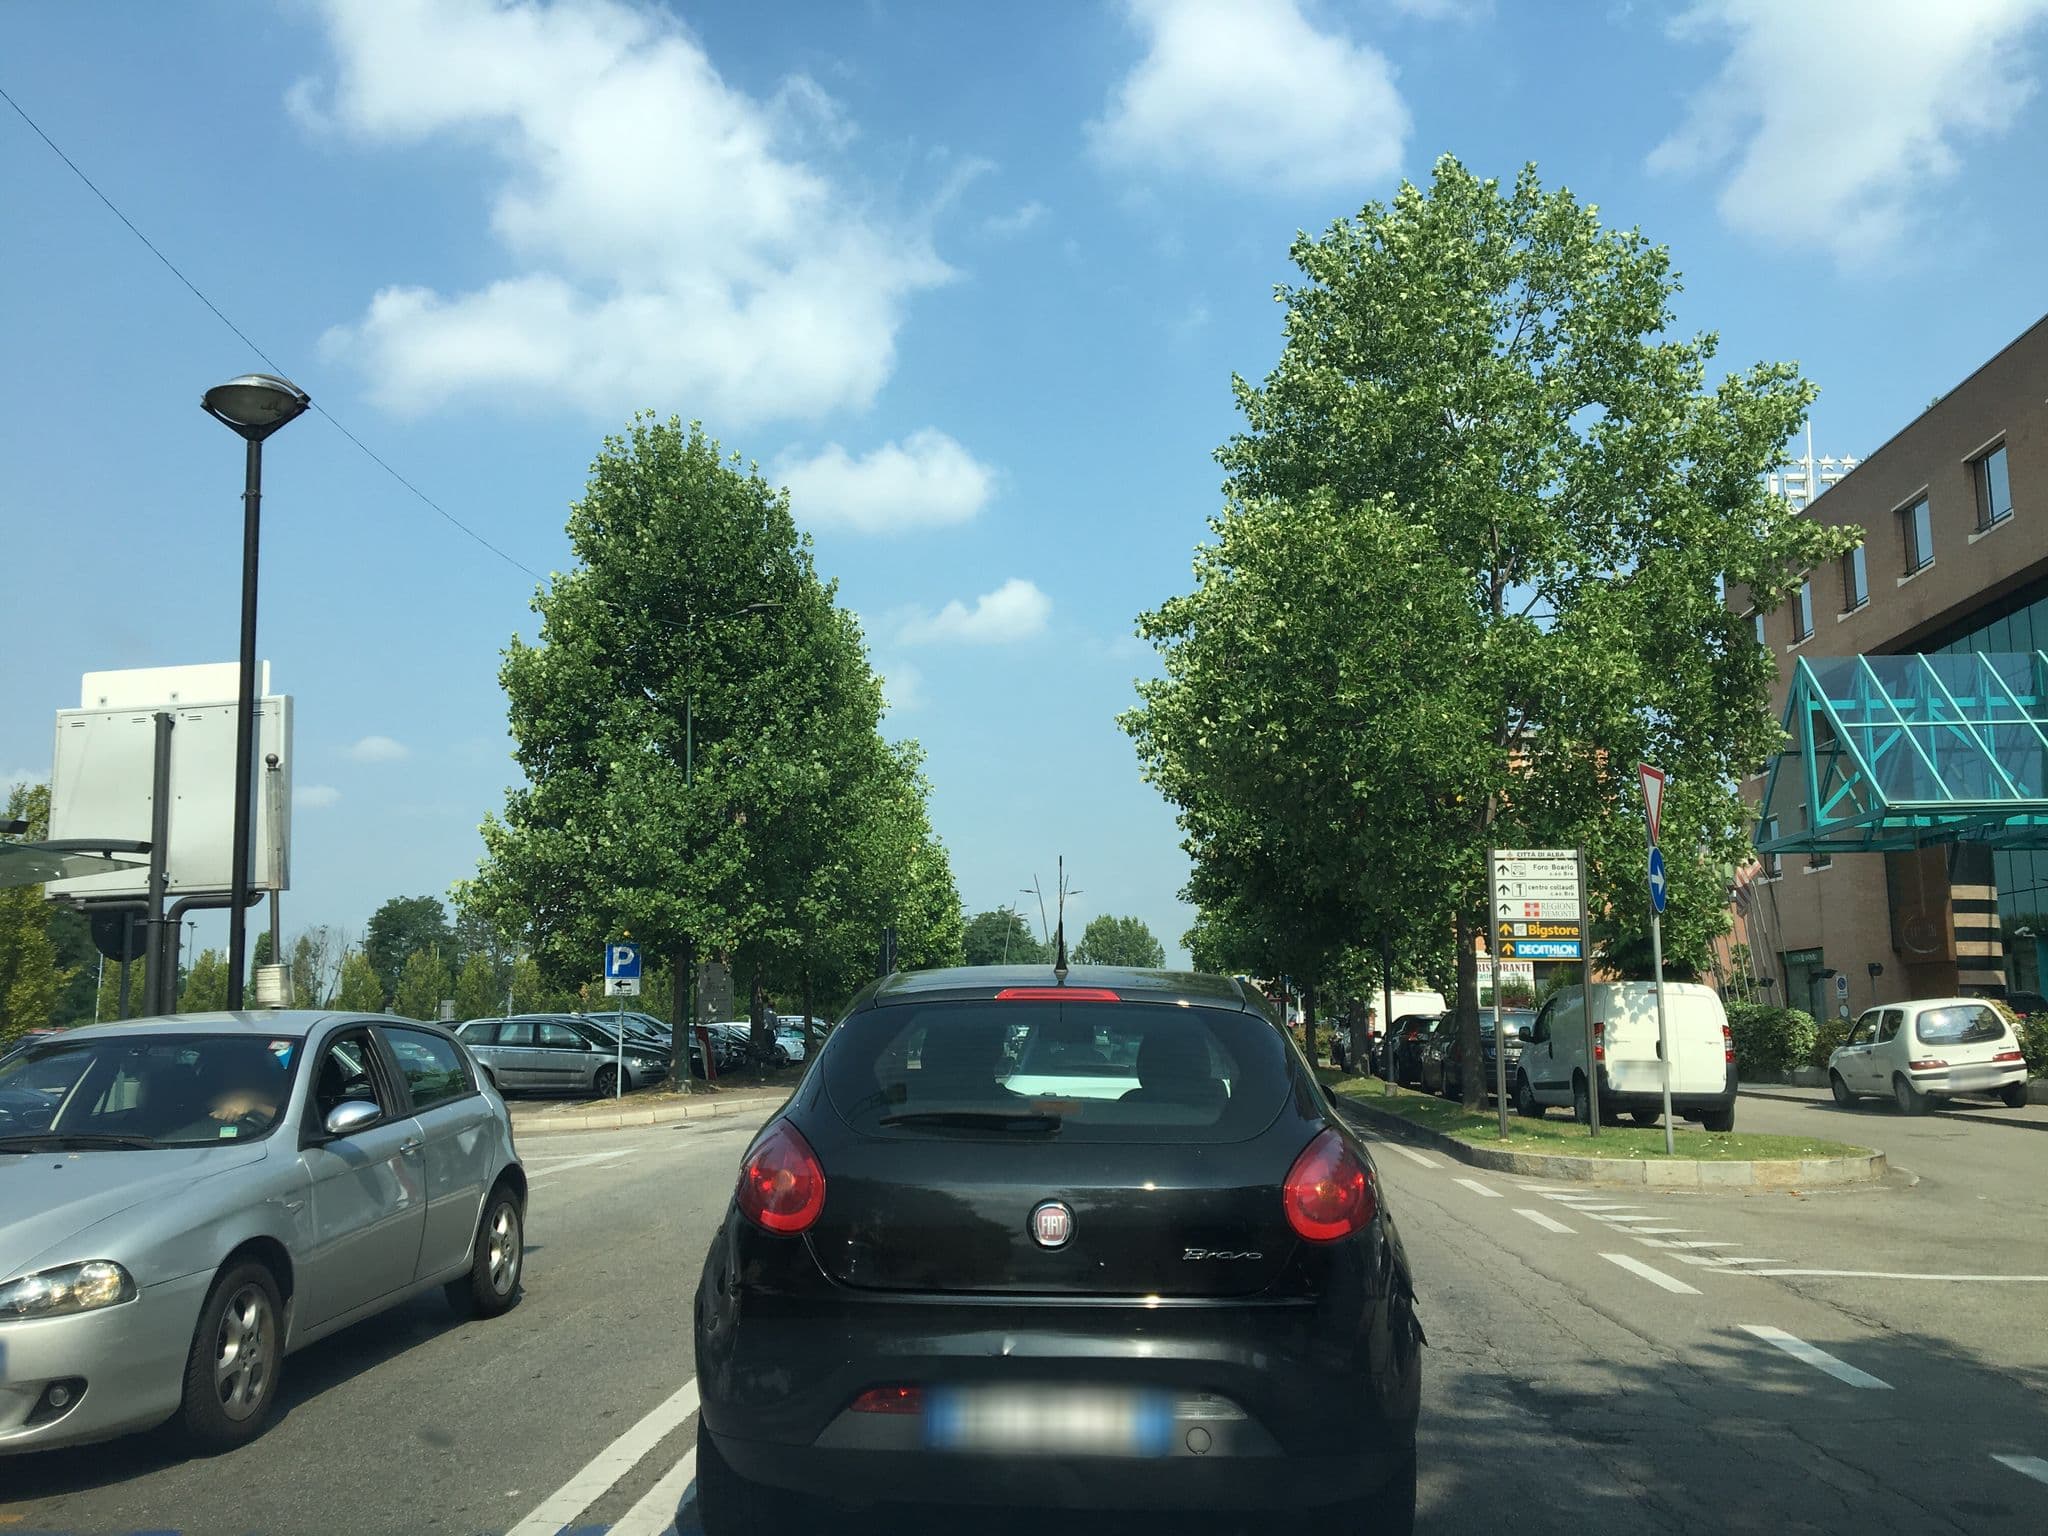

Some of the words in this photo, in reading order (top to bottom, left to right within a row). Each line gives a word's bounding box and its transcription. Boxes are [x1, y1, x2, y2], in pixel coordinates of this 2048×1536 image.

[1551, 863, 1574, 871] Boario
[1549, 883, 1575, 891] collaudi
[1541, 902, 1577, 910] REGIONE
[1541, 910, 1577, 918] PIEMONTE
[1528, 921, 1579, 938] Bigstore
[1518, 944, 1577, 955] DECATHLON
[612, 946, 635, 975] P
[1040, 1215, 1065, 1236] FIAT
[1182, 1248, 1264, 1260] Bravo
